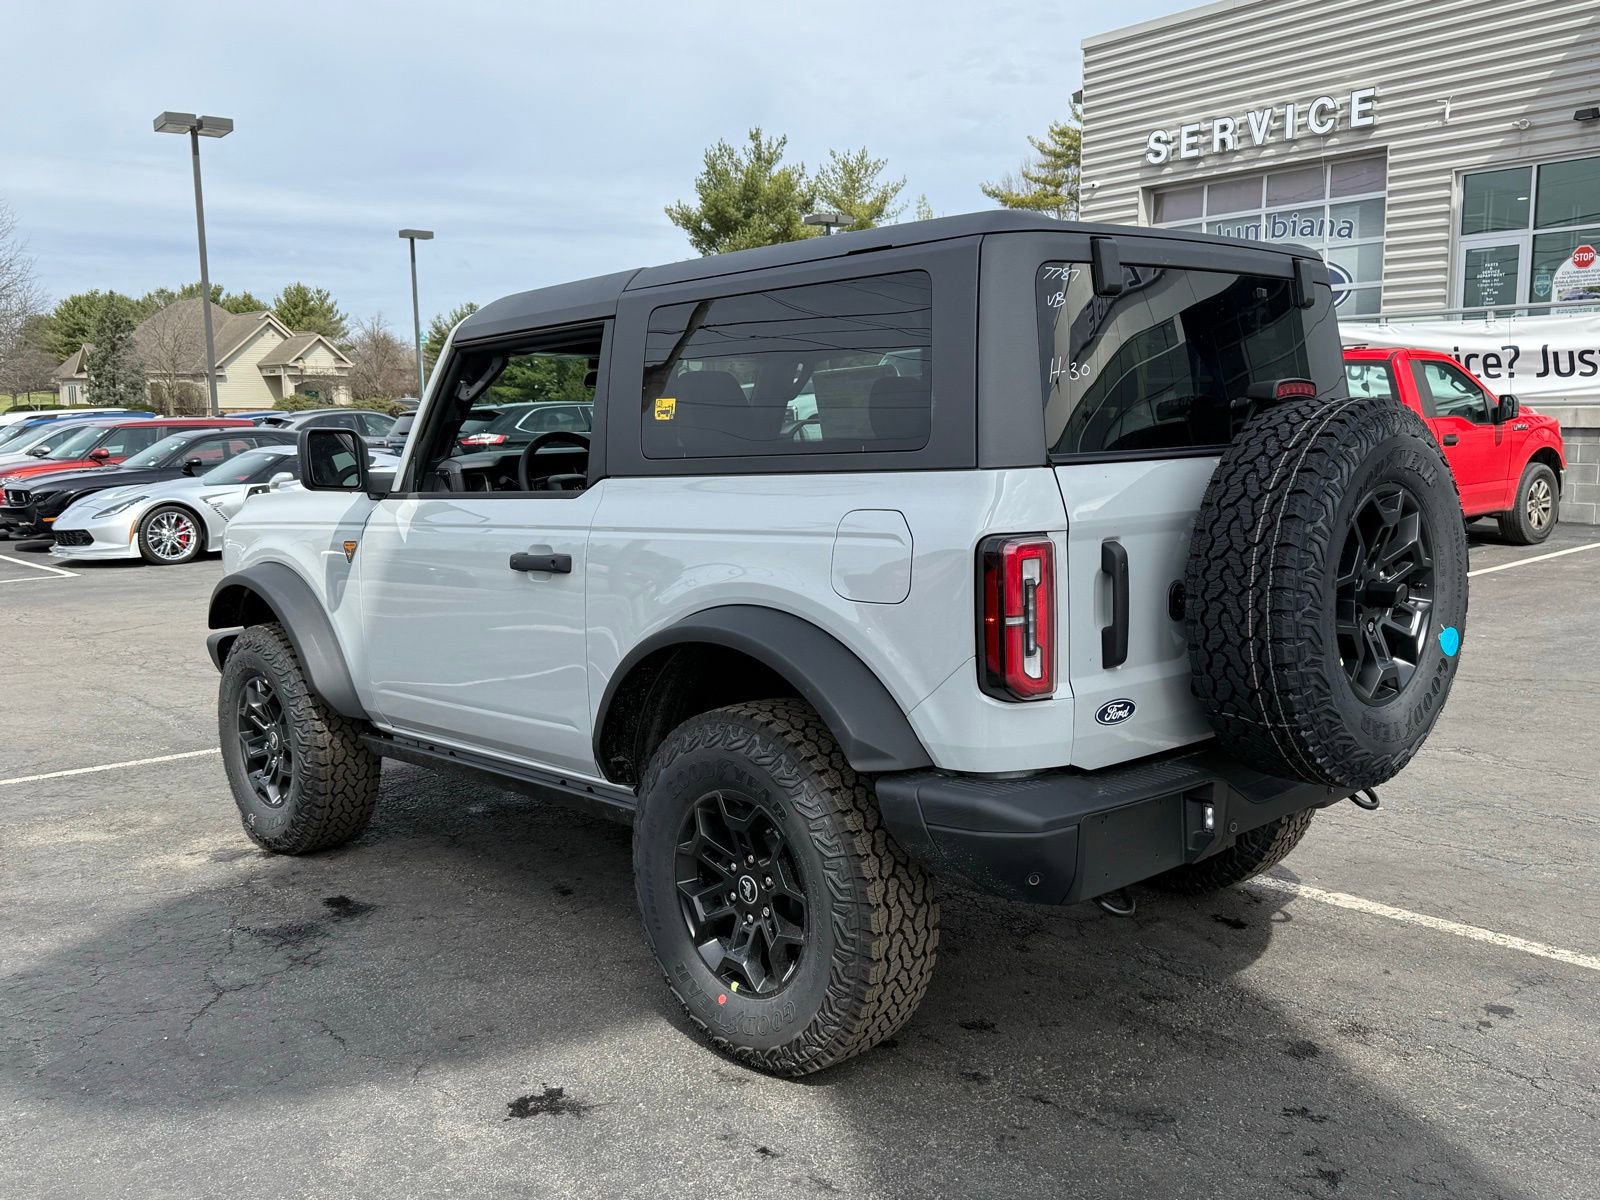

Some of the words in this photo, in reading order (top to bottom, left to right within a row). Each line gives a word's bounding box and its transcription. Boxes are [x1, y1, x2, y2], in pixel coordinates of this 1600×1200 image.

[1146, 87, 1376, 164] SERVICE
[1574, 252, 1594, 262] STOP
[1043, 267, 1080, 281] 7787
[1448, 345, 1520, 379] ice?
[1536, 344, 1600, 378] Jus
[1104, 703, 1130, 721] Ford
